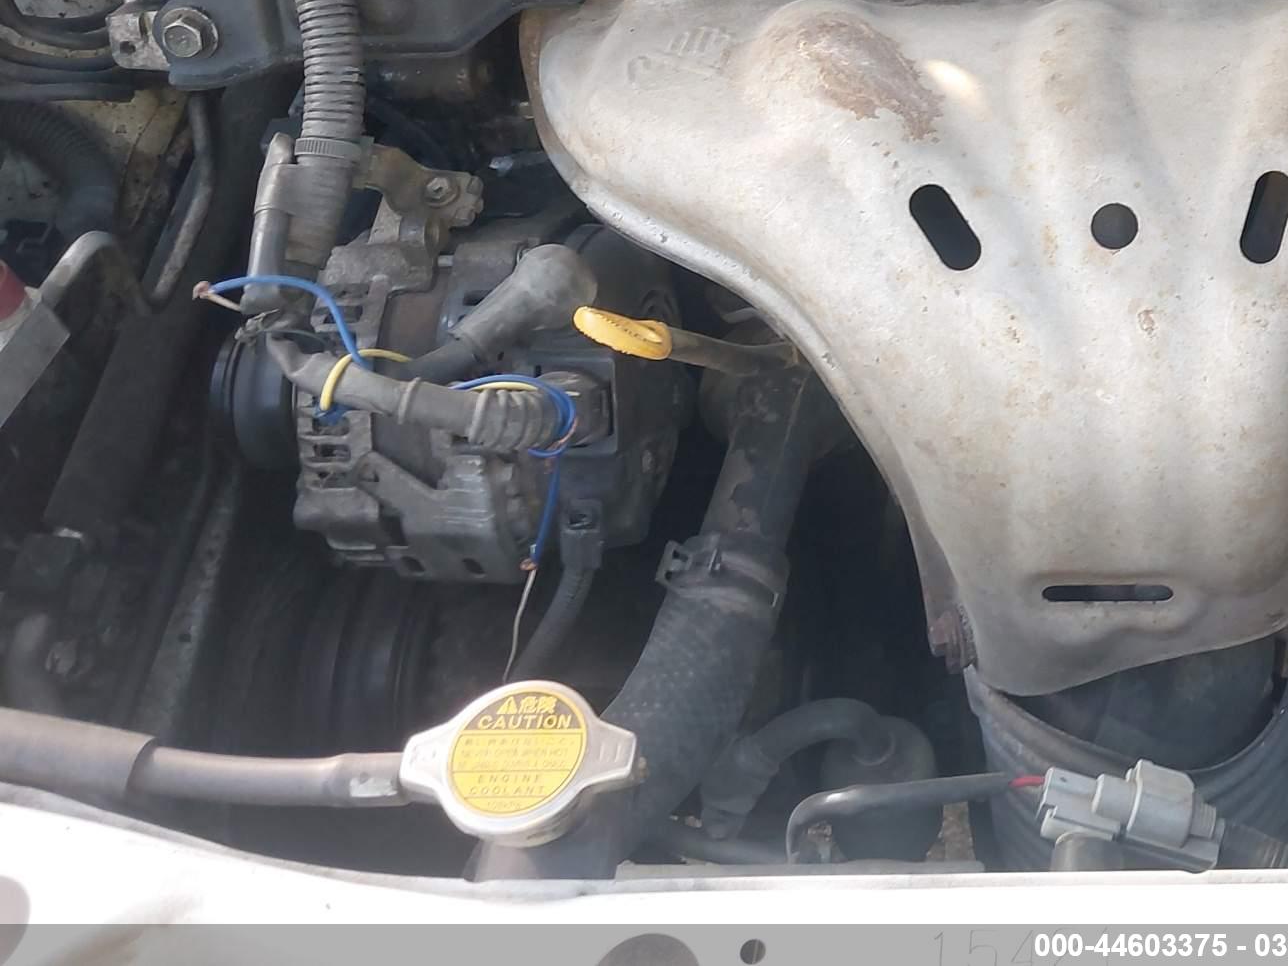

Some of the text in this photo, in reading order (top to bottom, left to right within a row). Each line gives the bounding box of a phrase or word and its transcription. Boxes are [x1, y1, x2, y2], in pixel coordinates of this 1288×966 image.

[477, 714, 573, 730] CAUTION
[477, 774, 541, 784] ENGINE
[470, 785, 546, 795] COOLANT
